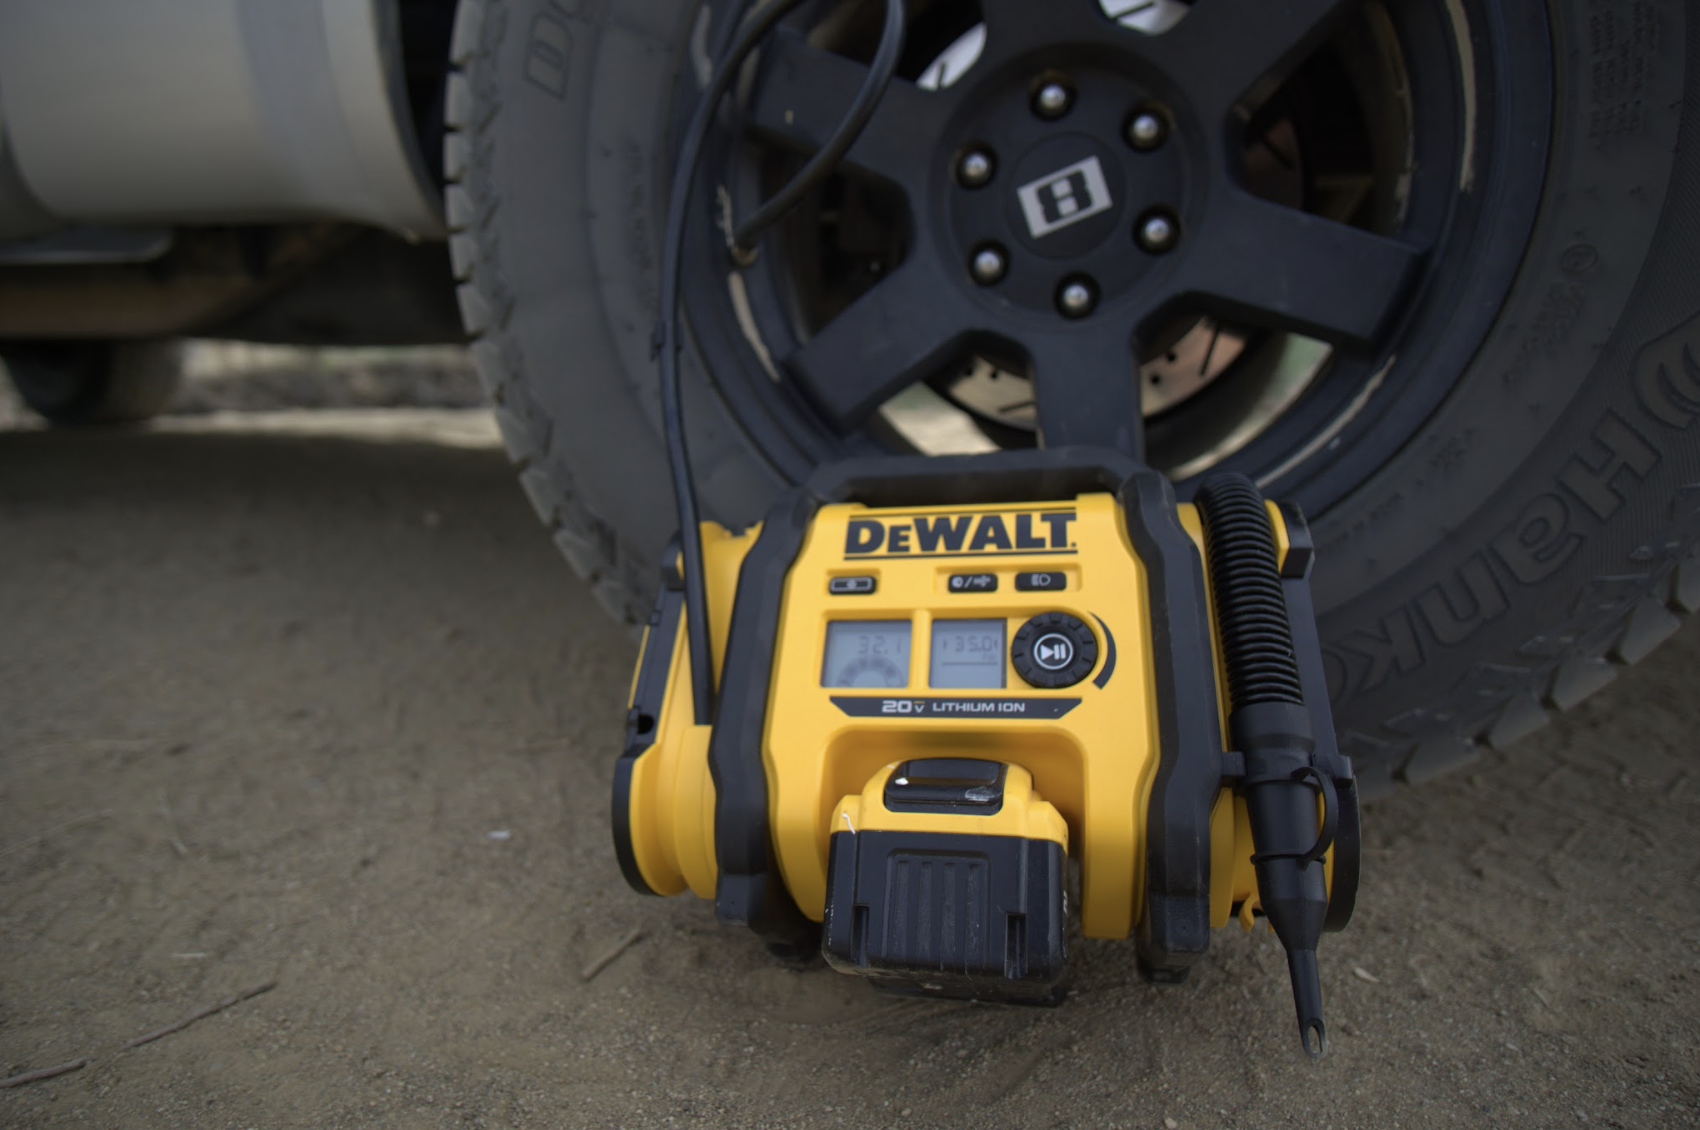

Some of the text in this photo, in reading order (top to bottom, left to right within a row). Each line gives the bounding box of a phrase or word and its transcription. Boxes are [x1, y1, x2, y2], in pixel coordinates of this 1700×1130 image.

[954, 634, 993, 653] 35.0
[932, 702, 995, 713] LITHIUM
[998, 702, 1026, 713] ION
